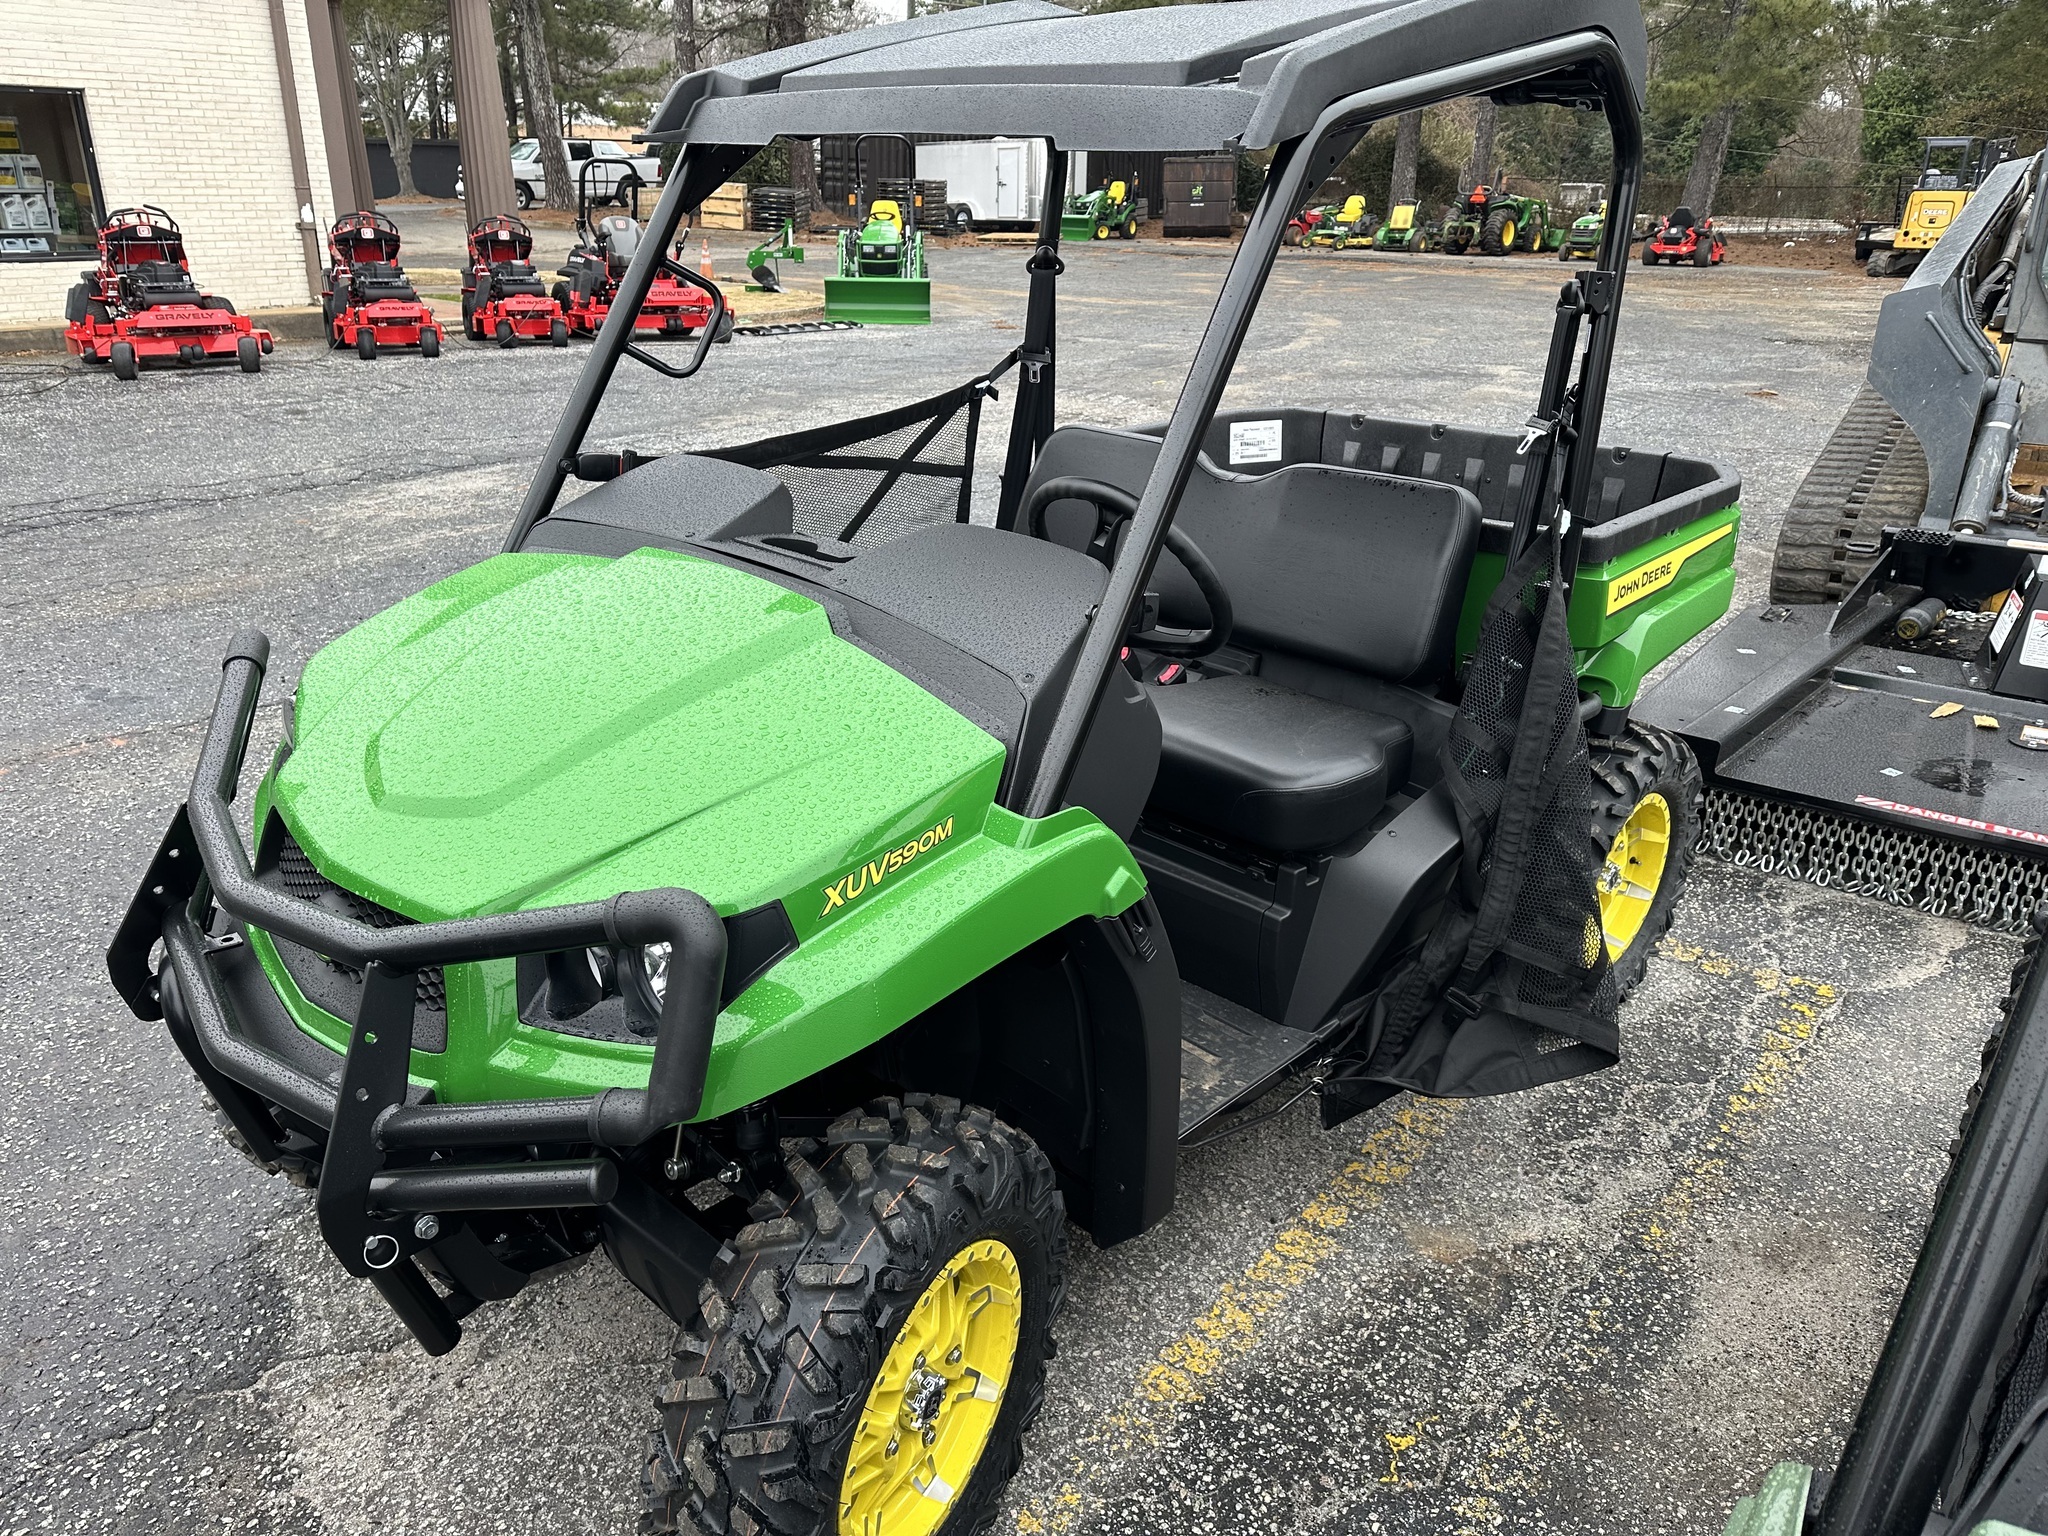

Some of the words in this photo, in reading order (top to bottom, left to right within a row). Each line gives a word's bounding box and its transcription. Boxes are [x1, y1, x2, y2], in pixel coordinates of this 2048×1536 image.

[1613, 578, 1640, 602] JOHN
[1641, 561, 1672, 587] DEERE
[1894, 803, 1987, 829] DANGER
[819, 815, 954, 920] XUV590M
